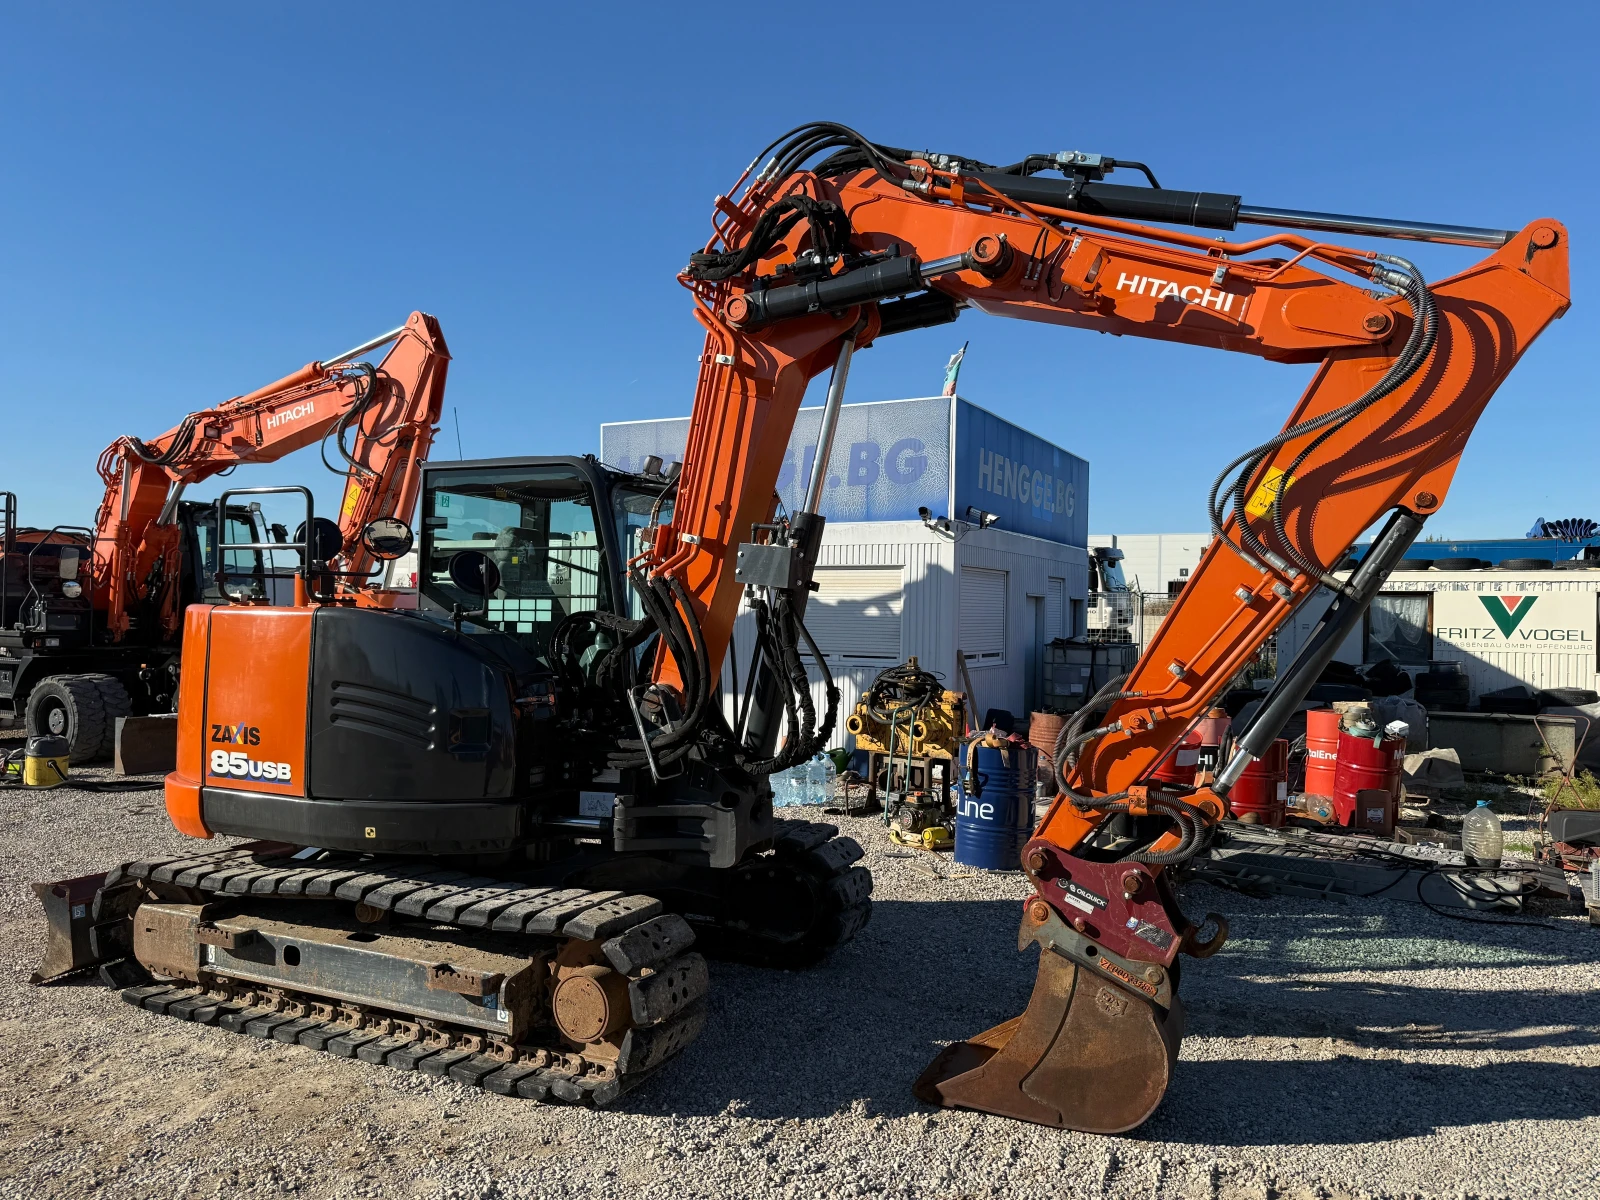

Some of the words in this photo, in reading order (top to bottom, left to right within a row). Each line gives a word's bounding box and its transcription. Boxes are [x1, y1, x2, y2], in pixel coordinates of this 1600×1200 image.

[1115, 272, 1234, 312] HITACHI
[266, 401, 315, 430] HITACHI
[978, 447, 1075, 518] HENGGE.BG
[1436, 627, 1496, 639] FRITZ
[1518, 628, 1593, 642] VOGEL
[1536, 643, 1593, 651] OFFENBURG
[211, 722, 261, 746] ZAXIS
[1076, 888, 1107, 907] OILQUICK
